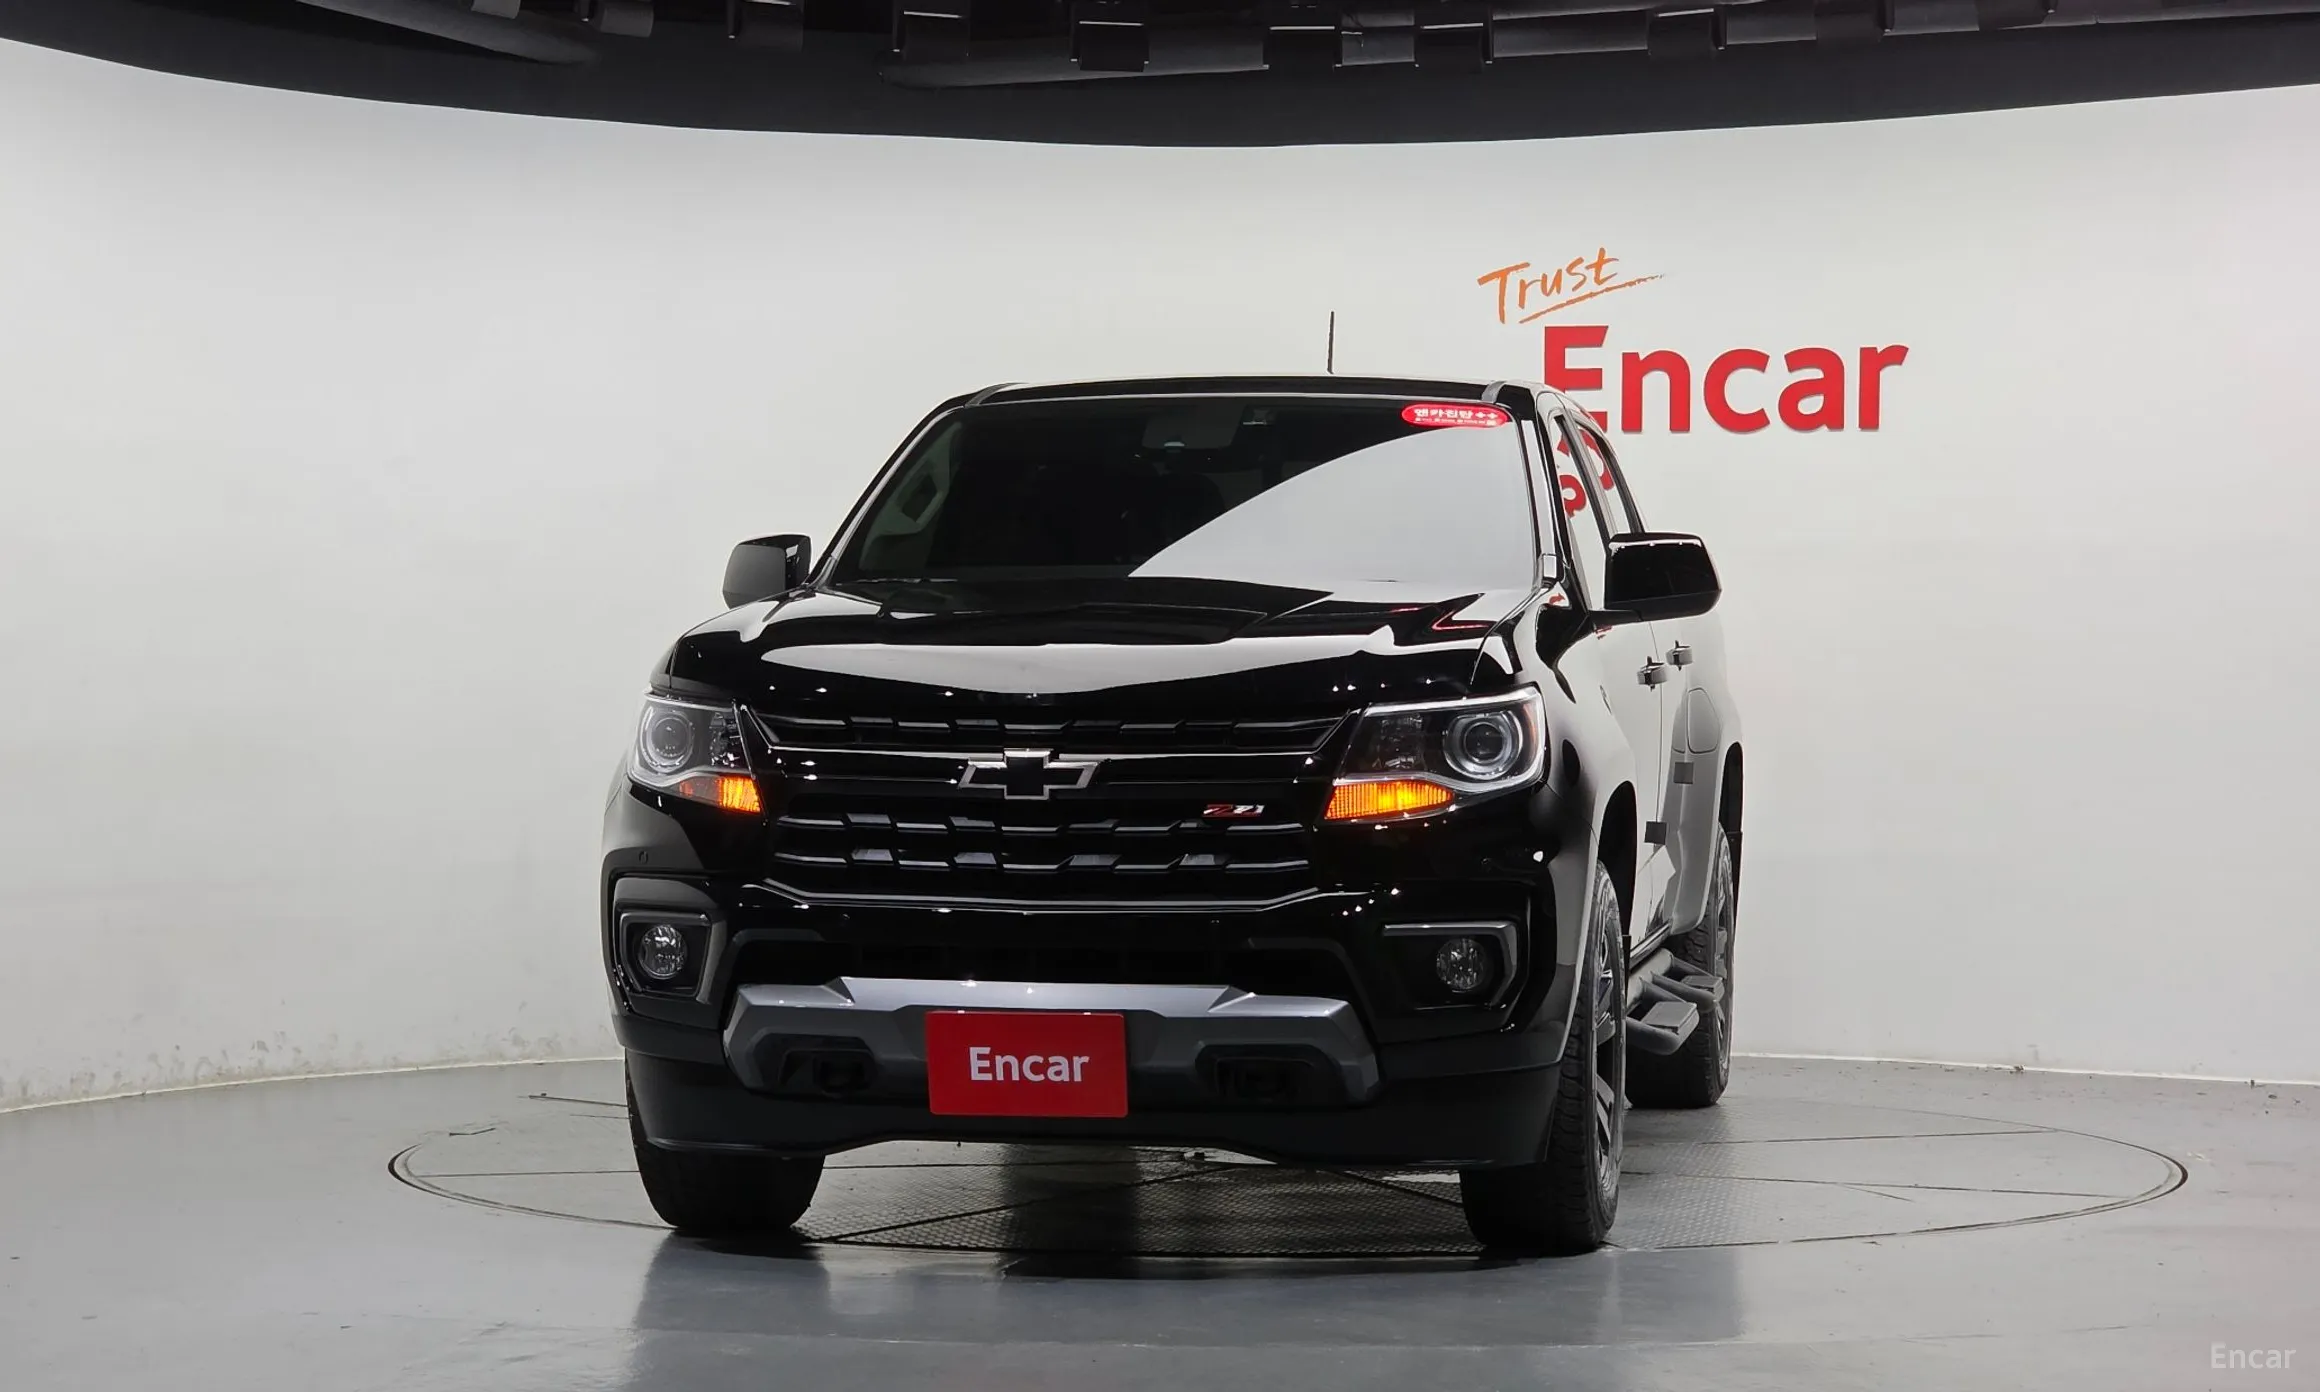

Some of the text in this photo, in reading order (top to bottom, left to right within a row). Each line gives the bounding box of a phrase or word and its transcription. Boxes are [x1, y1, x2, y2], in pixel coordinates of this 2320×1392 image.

[1477, 247, 1620, 324] Trust
[1544, 325, 1909, 433] Encar
[969, 1047, 1090, 1082] Encar
